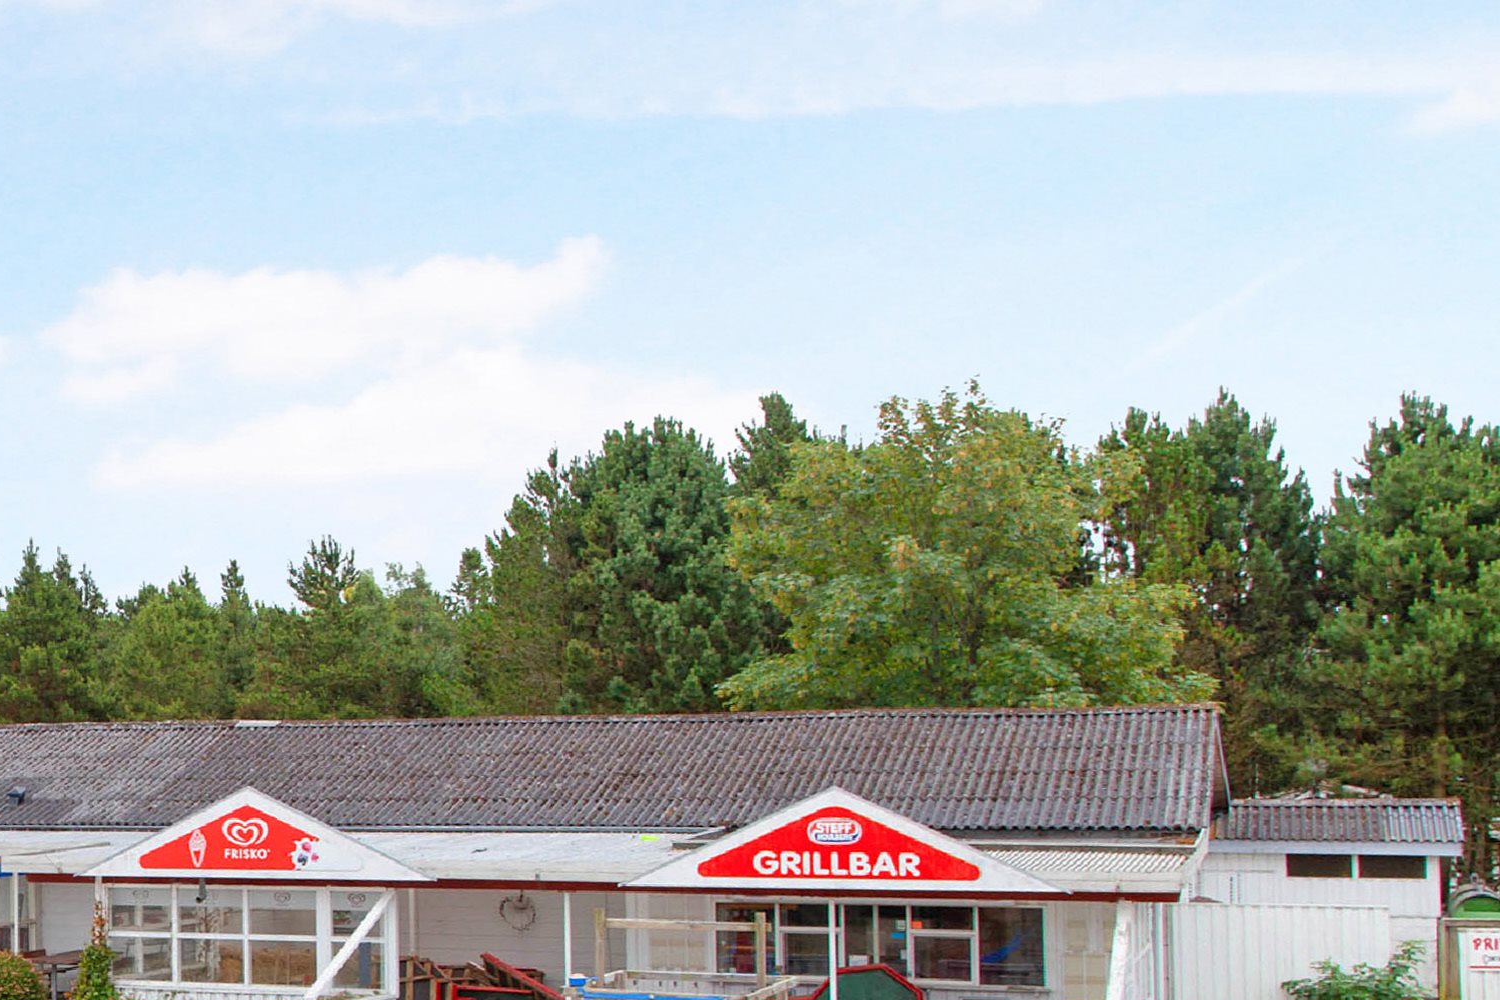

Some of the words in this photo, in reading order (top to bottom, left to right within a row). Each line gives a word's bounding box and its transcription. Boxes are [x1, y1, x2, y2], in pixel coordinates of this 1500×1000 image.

[814, 822, 853, 834] STEFF
[224, 848, 268, 859] FRISKO
[752, 850, 921, 877] GRILLBAR
